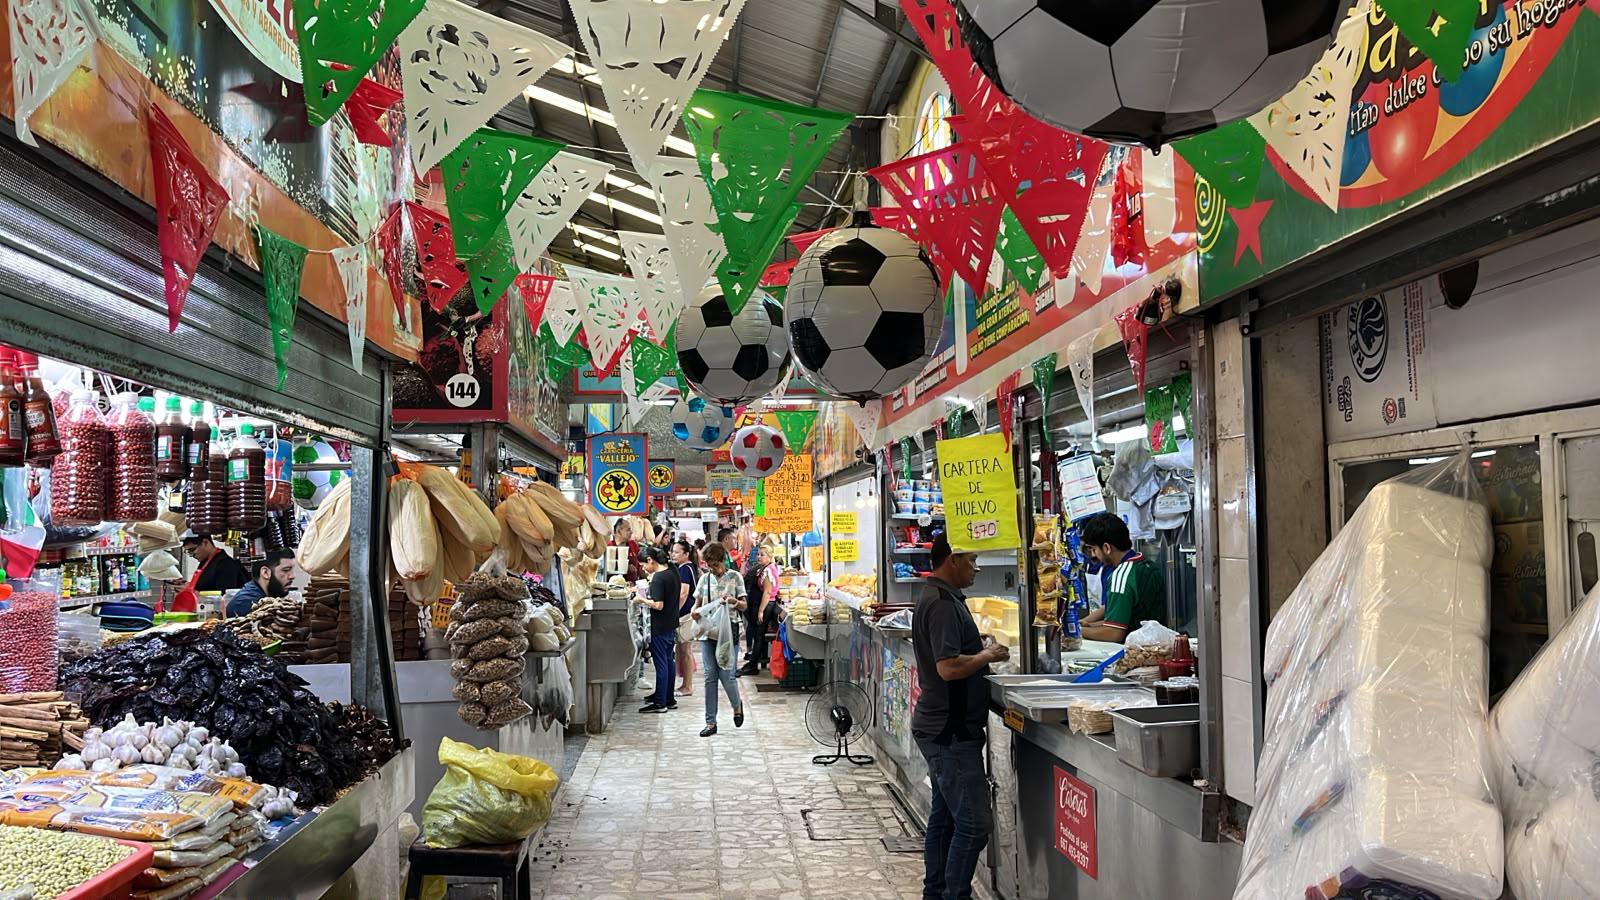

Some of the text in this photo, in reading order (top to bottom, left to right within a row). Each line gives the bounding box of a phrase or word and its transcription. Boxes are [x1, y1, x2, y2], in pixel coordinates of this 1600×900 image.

[257, 8, 299, 70] ABARROTES
[1384, 72, 1426, 113] dulce
[1432, 39, 1482, 84] co
[1488, 18, 1511, 52] su
[1349, 302, 1365, 368] REYM
[447, 382, 476, 399] 144
[1337, 385, 1345, 412] 500
[943, 457, 1004, 479] CARTERA
[969, 481, 984, 494] DE
[956, 499, 997, 516] HUEVO
[1060, 822, 1075, 843] Pedidos
